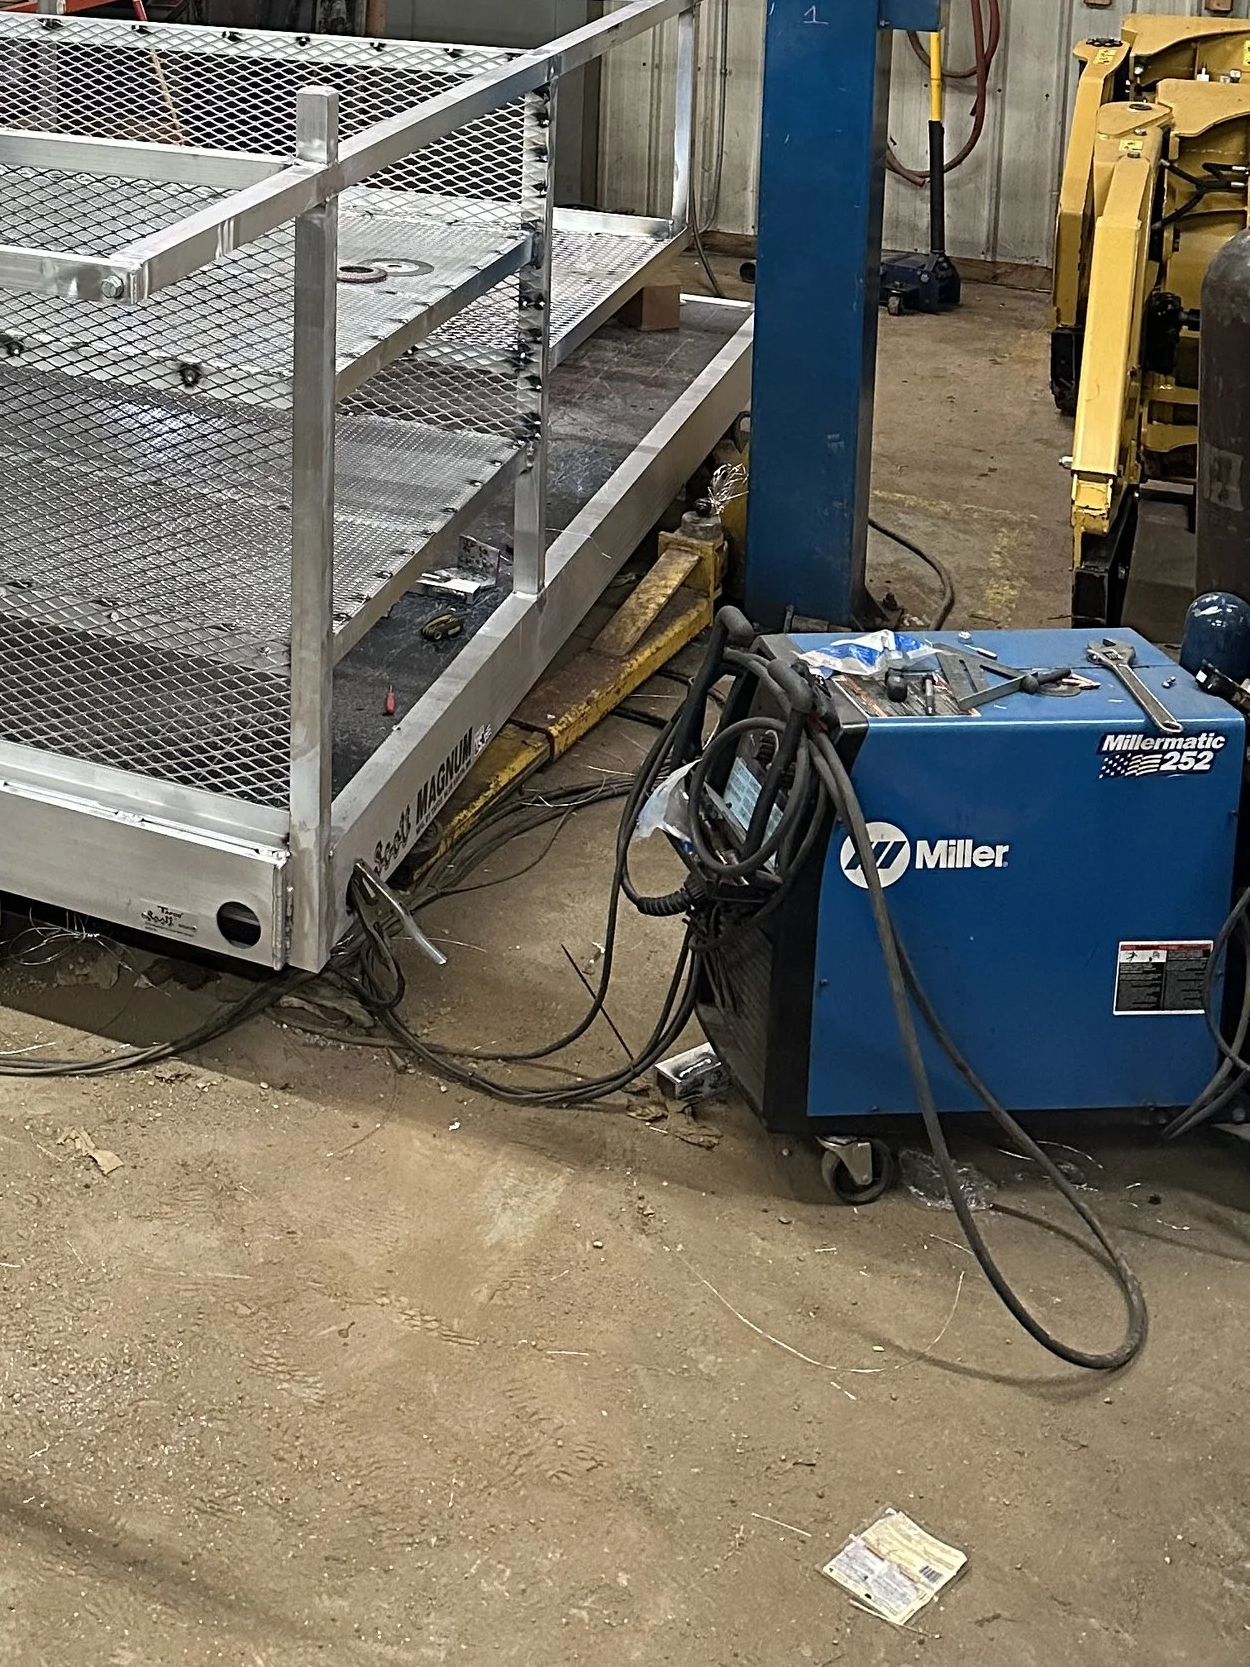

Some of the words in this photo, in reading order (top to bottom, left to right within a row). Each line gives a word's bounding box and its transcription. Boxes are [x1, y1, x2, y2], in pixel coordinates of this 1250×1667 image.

[1102, 732, 1226, 751] Millermatic
[1159, 750, 1214, 771] 252
[373, 803, 411, 877] Scott
[415, 726, 473, 826] MAGNUM
[915, 839, 1009, 869] Miller
